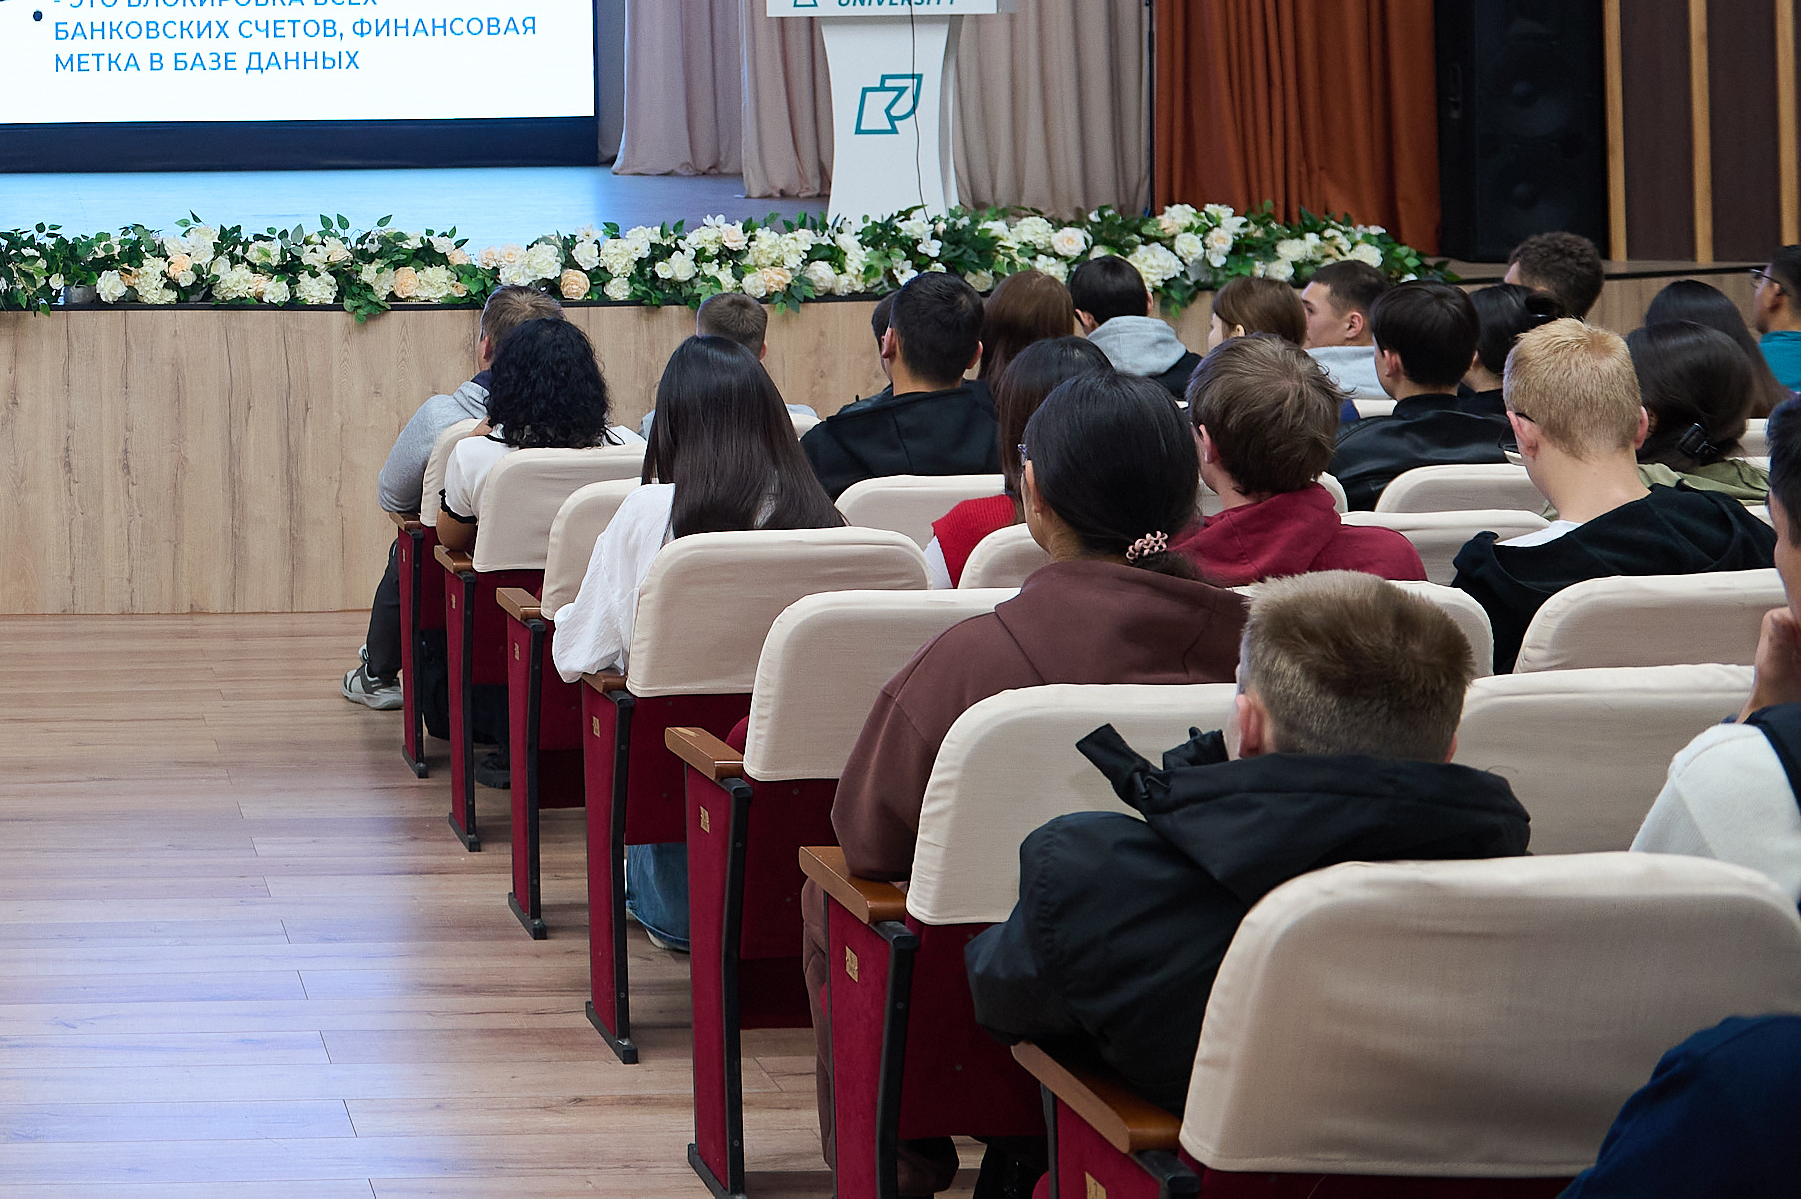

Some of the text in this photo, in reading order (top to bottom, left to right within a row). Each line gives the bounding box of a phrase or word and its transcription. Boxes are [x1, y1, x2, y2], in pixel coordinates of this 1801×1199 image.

[54, 15, 536, 43] БАНКОВСКИХ СЧЕТОВ, ФИНАНСОВАЯ
[54, 50, 360, 76] МЕТКА В БАЗЕ ДАННЫХ
